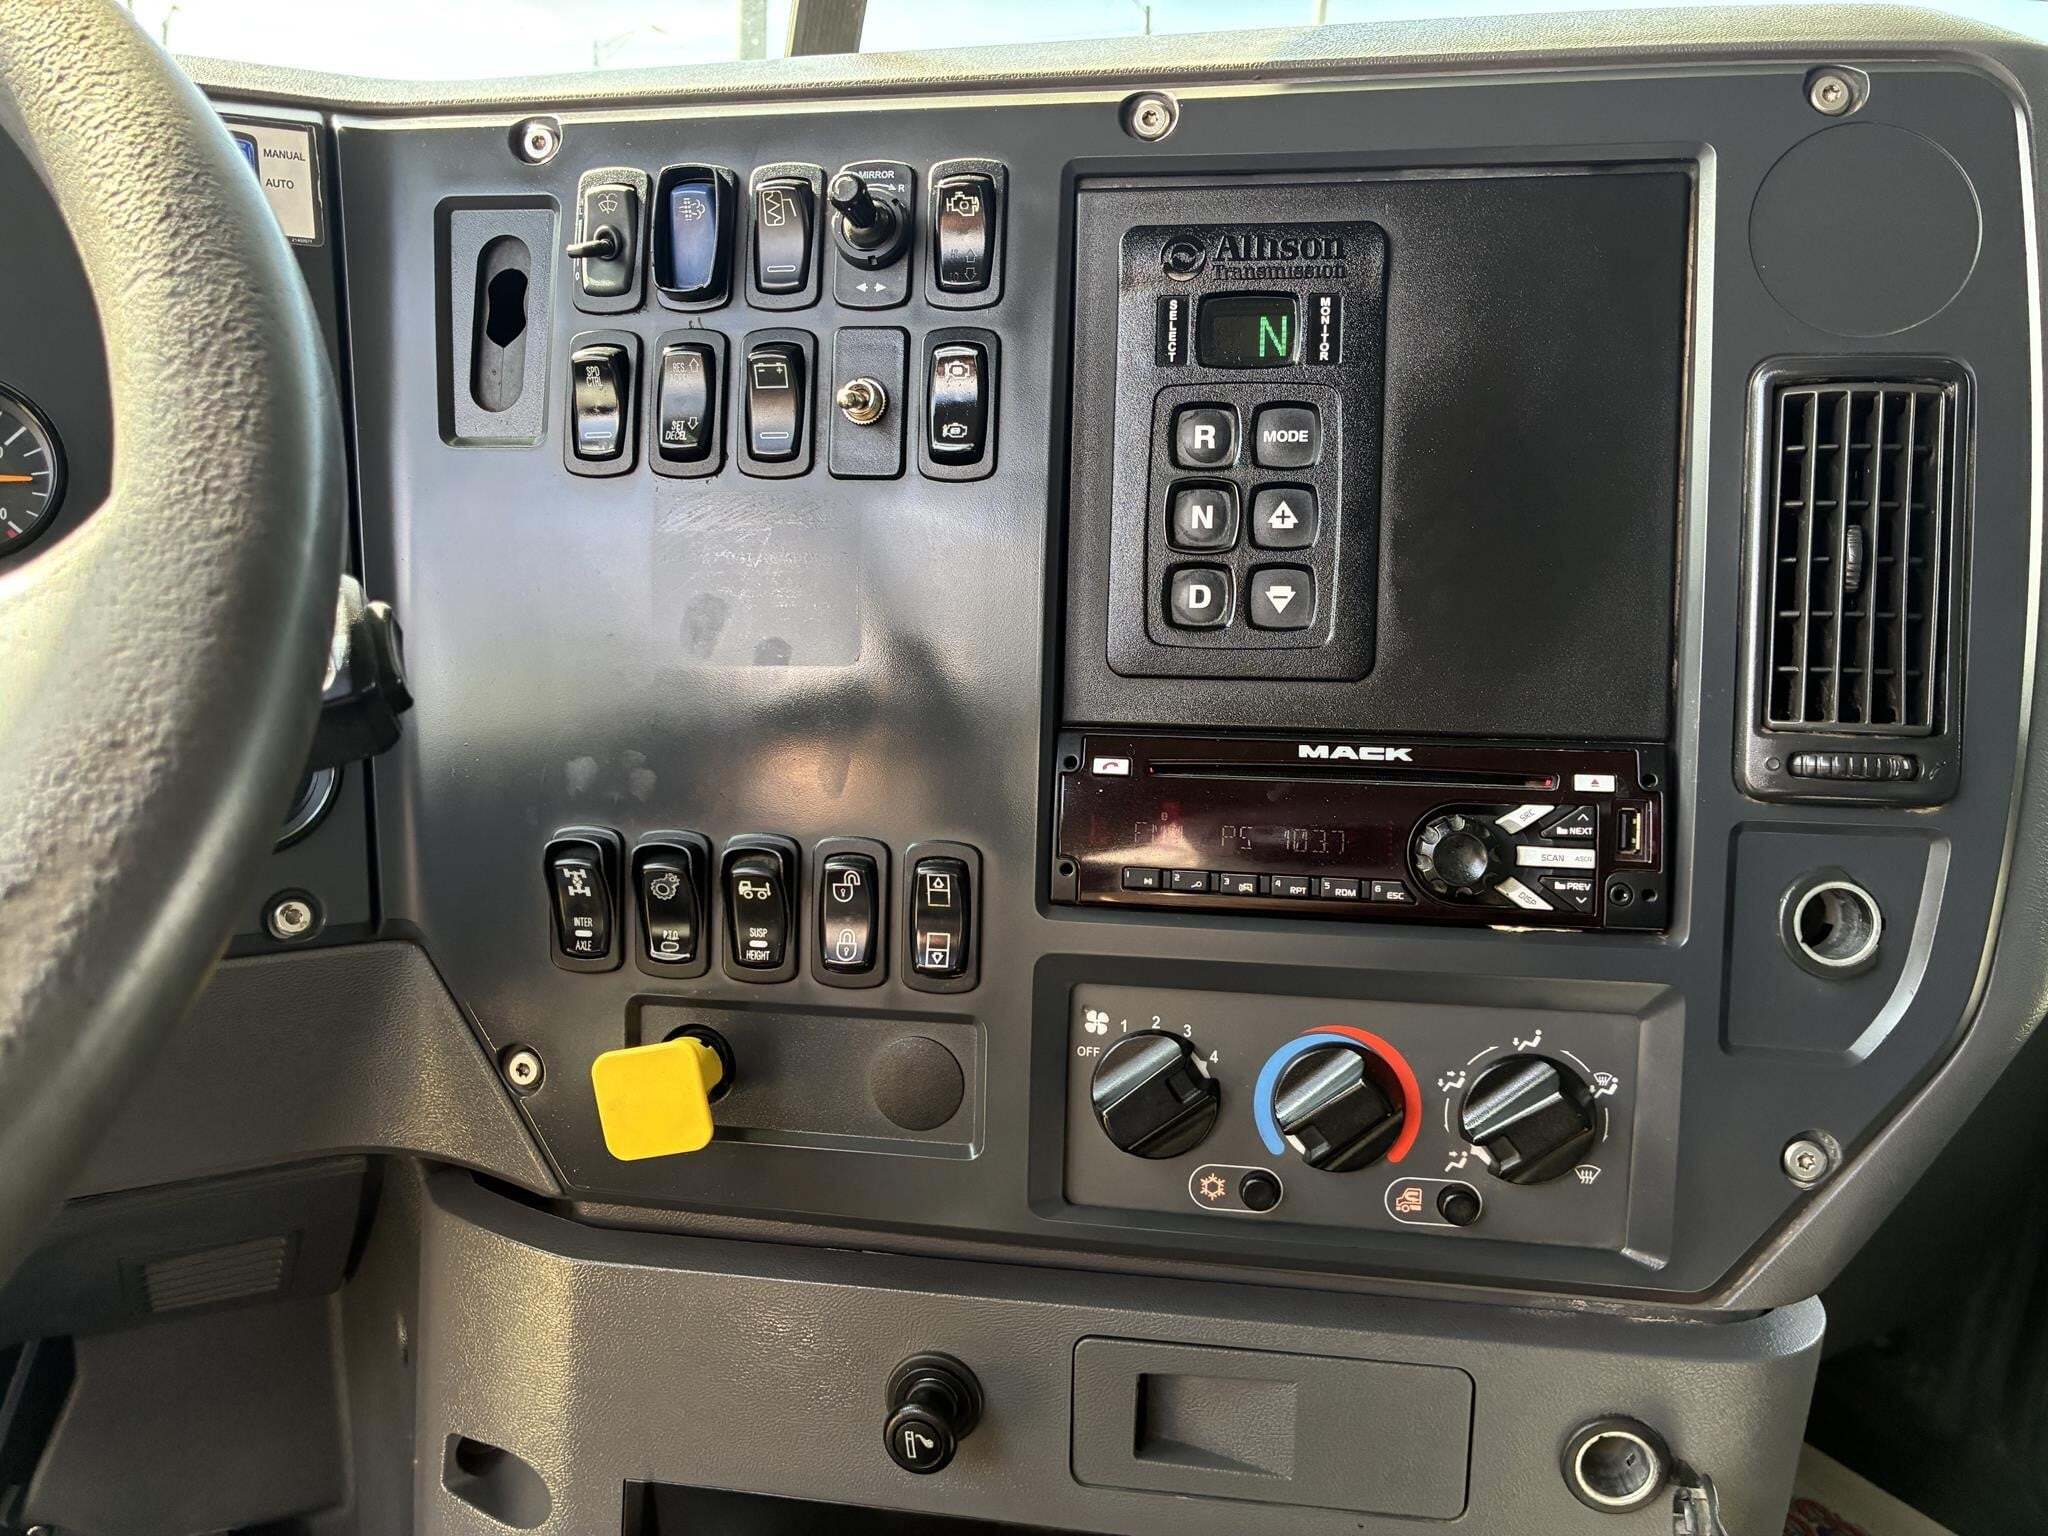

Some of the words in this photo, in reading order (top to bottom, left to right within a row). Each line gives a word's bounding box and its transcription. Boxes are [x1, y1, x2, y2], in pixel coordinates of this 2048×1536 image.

[263, 148, 306, 162] MANUAL
[858, 170, 895, 179] MIRROR
[265, 178, 295, 189] AUTO
[898, 185, 905, 193] R
[1212, 233, 1347, 261] Allison
[1212, 264, 1348, 281] Transmission
[1167, 299, 1178, 363] SELECT
[1318, 297, 1331, 361] MONITOR
[1259, 316, 1288, 358] N
[586, 366, 600, 376] SPD
[586, 376, 603, 387] CTRL
[671, 420, 685, 431] SET
[665, 431, 687, 441] DECEL
[1194, 424, 1216, 449] R
[1263, 430, 1309, 443] MODE
[1191, 505, 1214, 529] N
[1188, 584, 1212, 609] D
[1298, 744, 1414, 762] MACK
[1569, 827, 1594, 836] NEXT
[1541, 854, 1565, 862] SCAN
[1174, 873, 1180, 882] 2
[1223, 877, 1230, 885] 3
[1275, 879, 1281, 887] 4
[1289, 886, 1307, 896] RPT
[1324, 881, 1331, 890] 5
[1335, 888, 1357, 897] RDM
[1374, 884, 1381, 893] 6
[1386, 892, 1405, 900] ESC
[1567, 882, 1592, 891] PREV
[1518, 891, 1537, 905] DISP
[573, 917, 593, 928] INTER
[749, 927, 768, 938] SUSP
[575, 940, 592, 951] AXLE
[746, 950, 770, 961] HEIGHT
[1120, 1019, 1127, 1033] 1
[1151, 1015, 1161, 1029] 2
[1183, 1024, 1192, 1038] 3
[1076, 1046, 1100, 1057] OFF
[1209, 1050, 1219, 1063] 4
